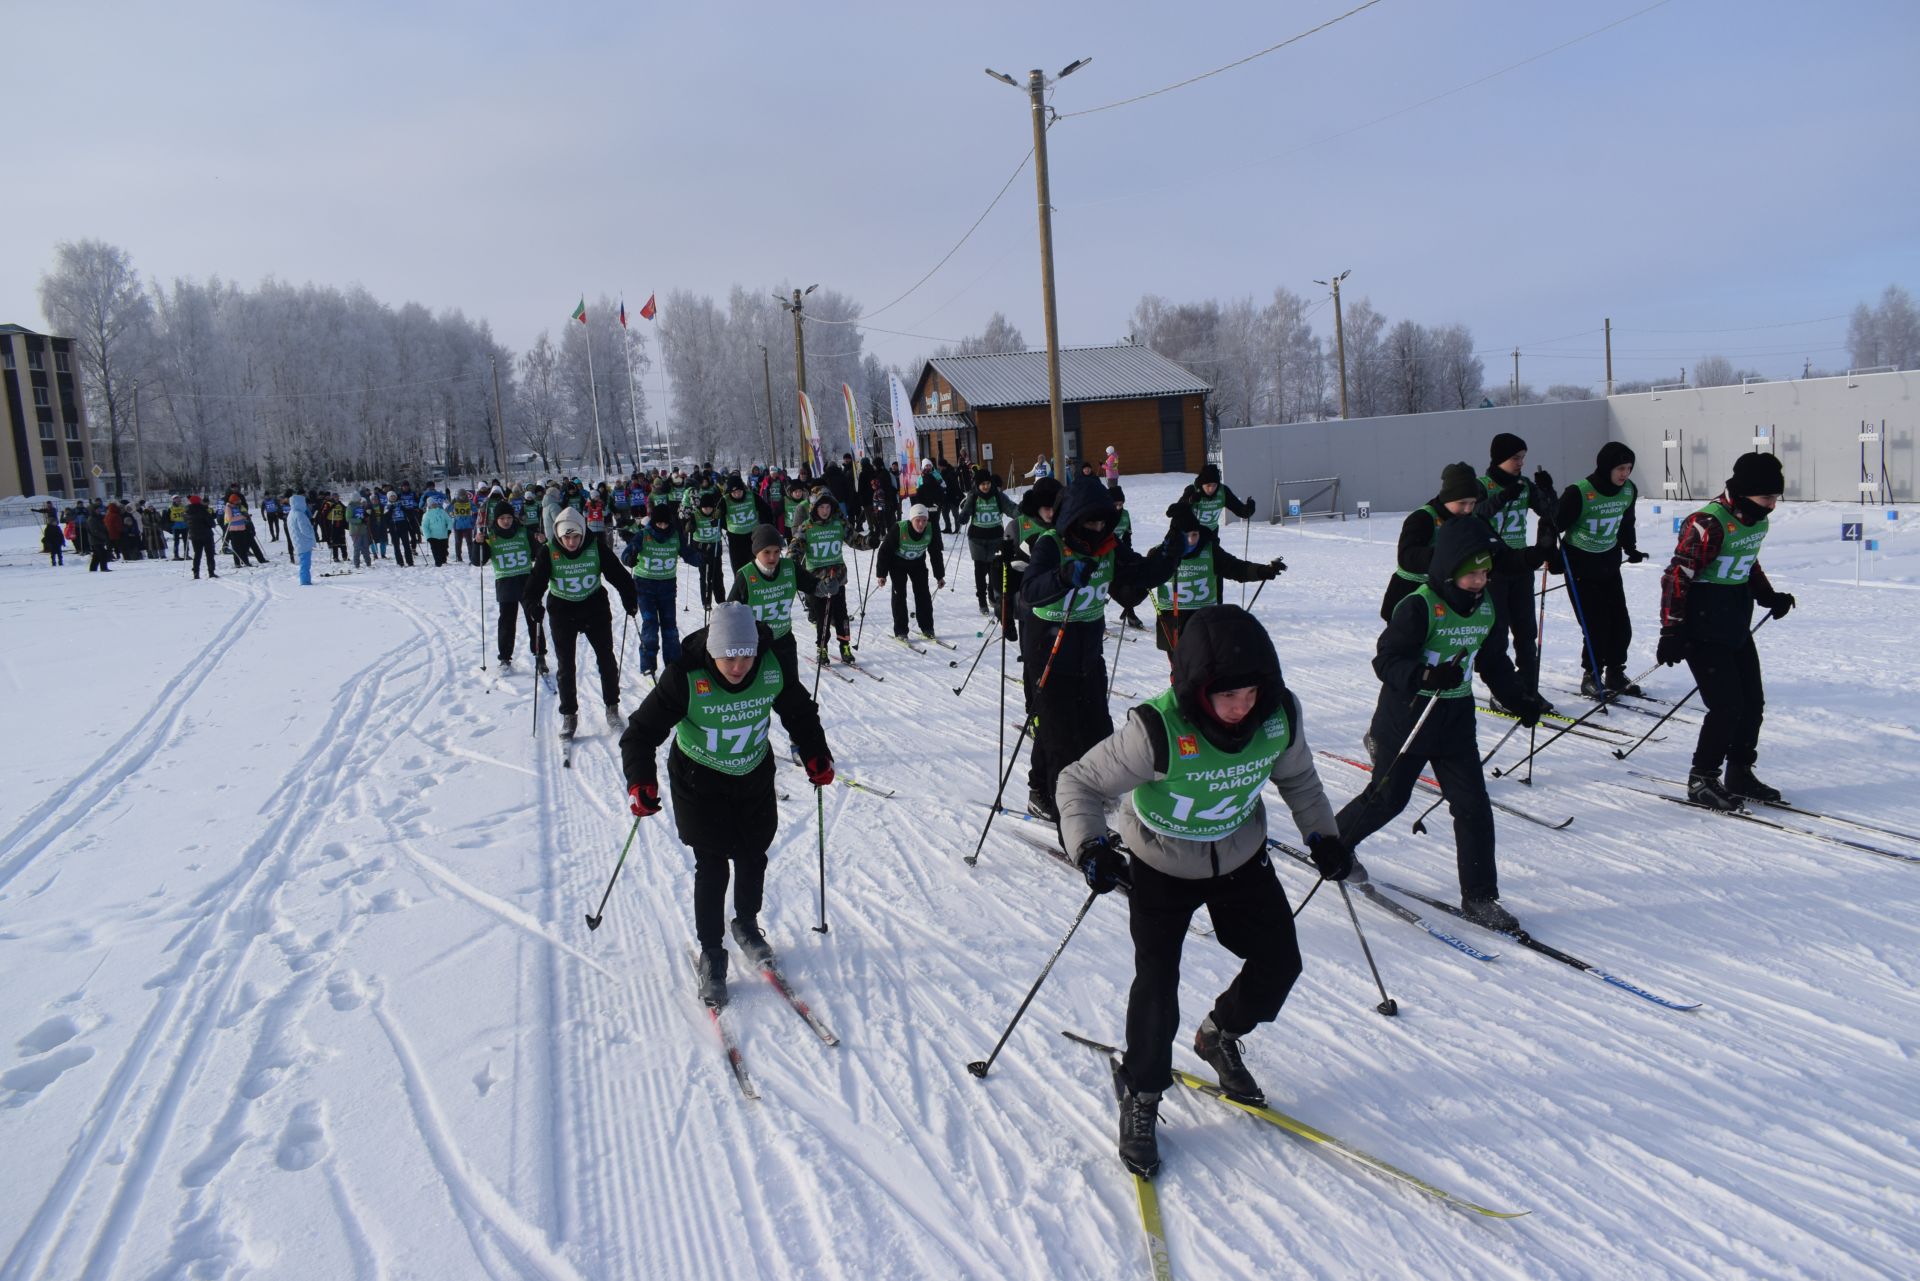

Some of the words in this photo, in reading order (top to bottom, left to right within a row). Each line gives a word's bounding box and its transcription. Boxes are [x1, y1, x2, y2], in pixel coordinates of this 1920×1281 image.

[593, 511, 599, 519] 5
[730, 511, 755, 524] 134
[1292, 507, 1299, 517] 9
[1360, 508, 1367, 519] 8
[1846, 523, 1858, 540] 4
[810, 541, 841, 558] 170
[496, 551, 528, 569] 135
[555, 574, 597, 593] 130
[1165, 577, 1210, 603] 153
[752, 599, 793, 622] 133
[1450, 636, 1478, 645] РАЙОН
[702, 694, 776, 714] ТУКАЕВСКИЙ
[721, 709, 762, 723] РАЙОН
[1186, 751, 1280, 781] ТУКАЕВСКИЙ
[1209, 772, 1262, 792] РАЙОН
